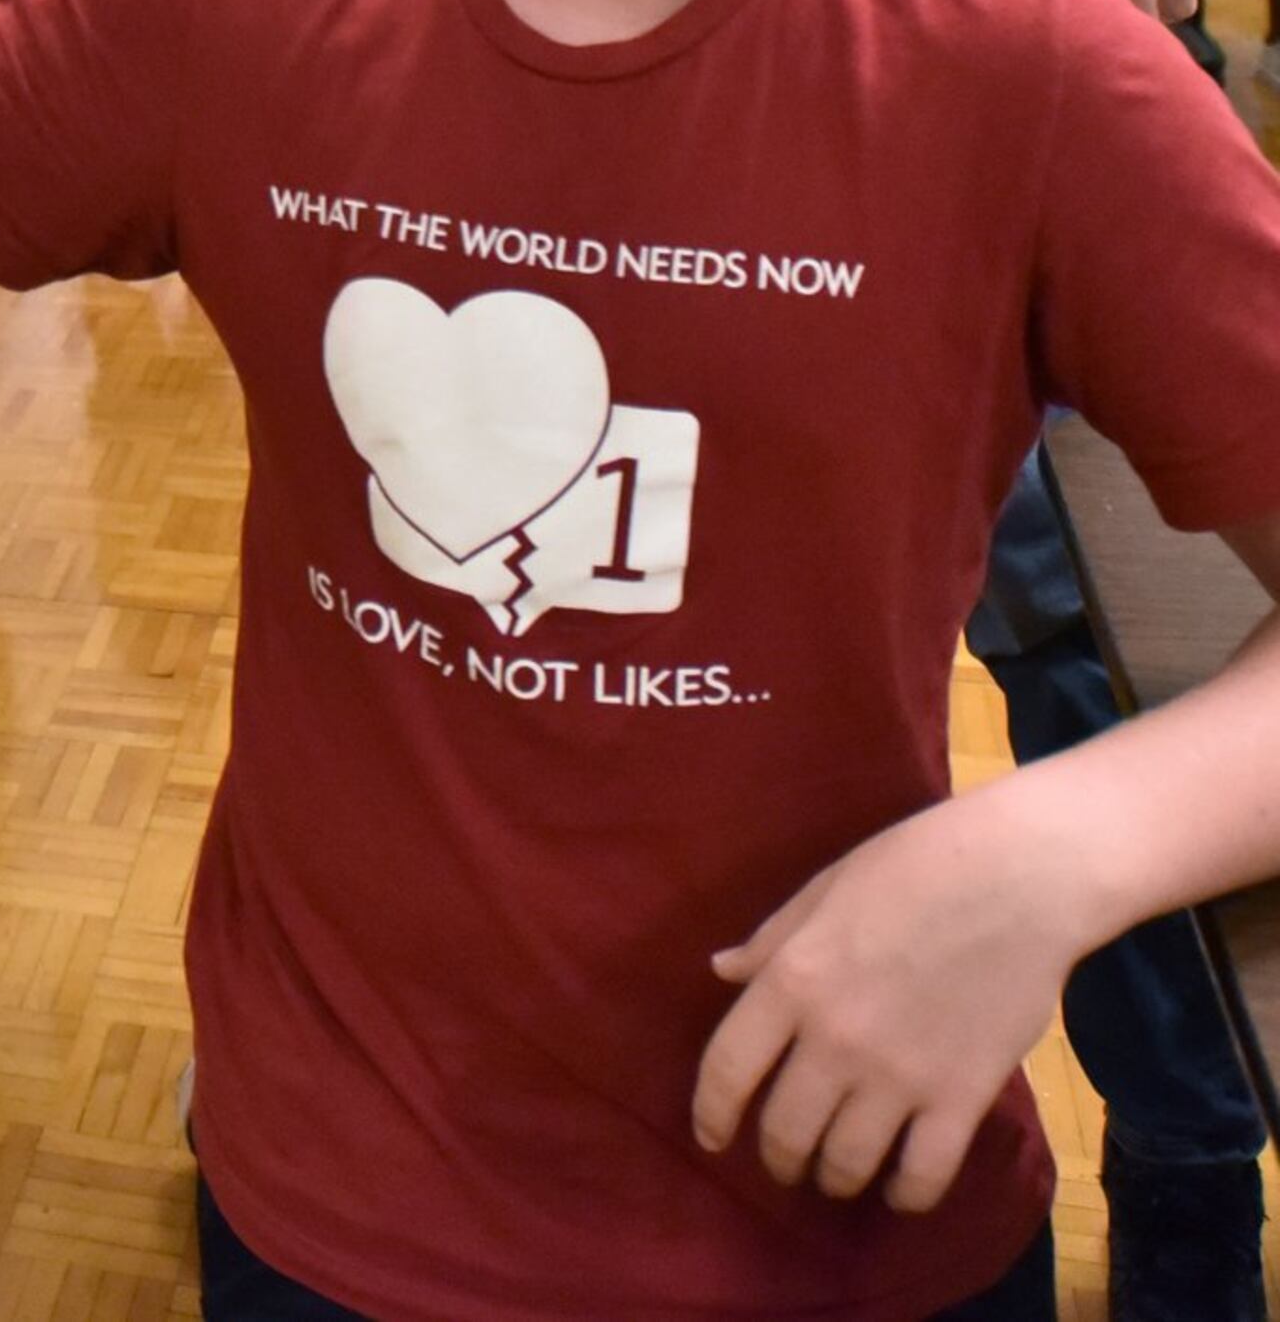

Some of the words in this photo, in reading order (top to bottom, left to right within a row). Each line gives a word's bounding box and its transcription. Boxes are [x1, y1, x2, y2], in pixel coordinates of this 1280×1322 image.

[269, 184, 367, 232] WHAT
[374, 203, 450, 252] THE
[459, 220, 608, 276] WORLD
[615, 242, 747, 289] NEEDS
[756, 256, 864, 299] NOW
[591, 456, 646, 583] 1
[339, 587, 455, 677] LOVE,
[466, 646, 579, 702] NOT
[593, 663, 772, 707] LIKES...
